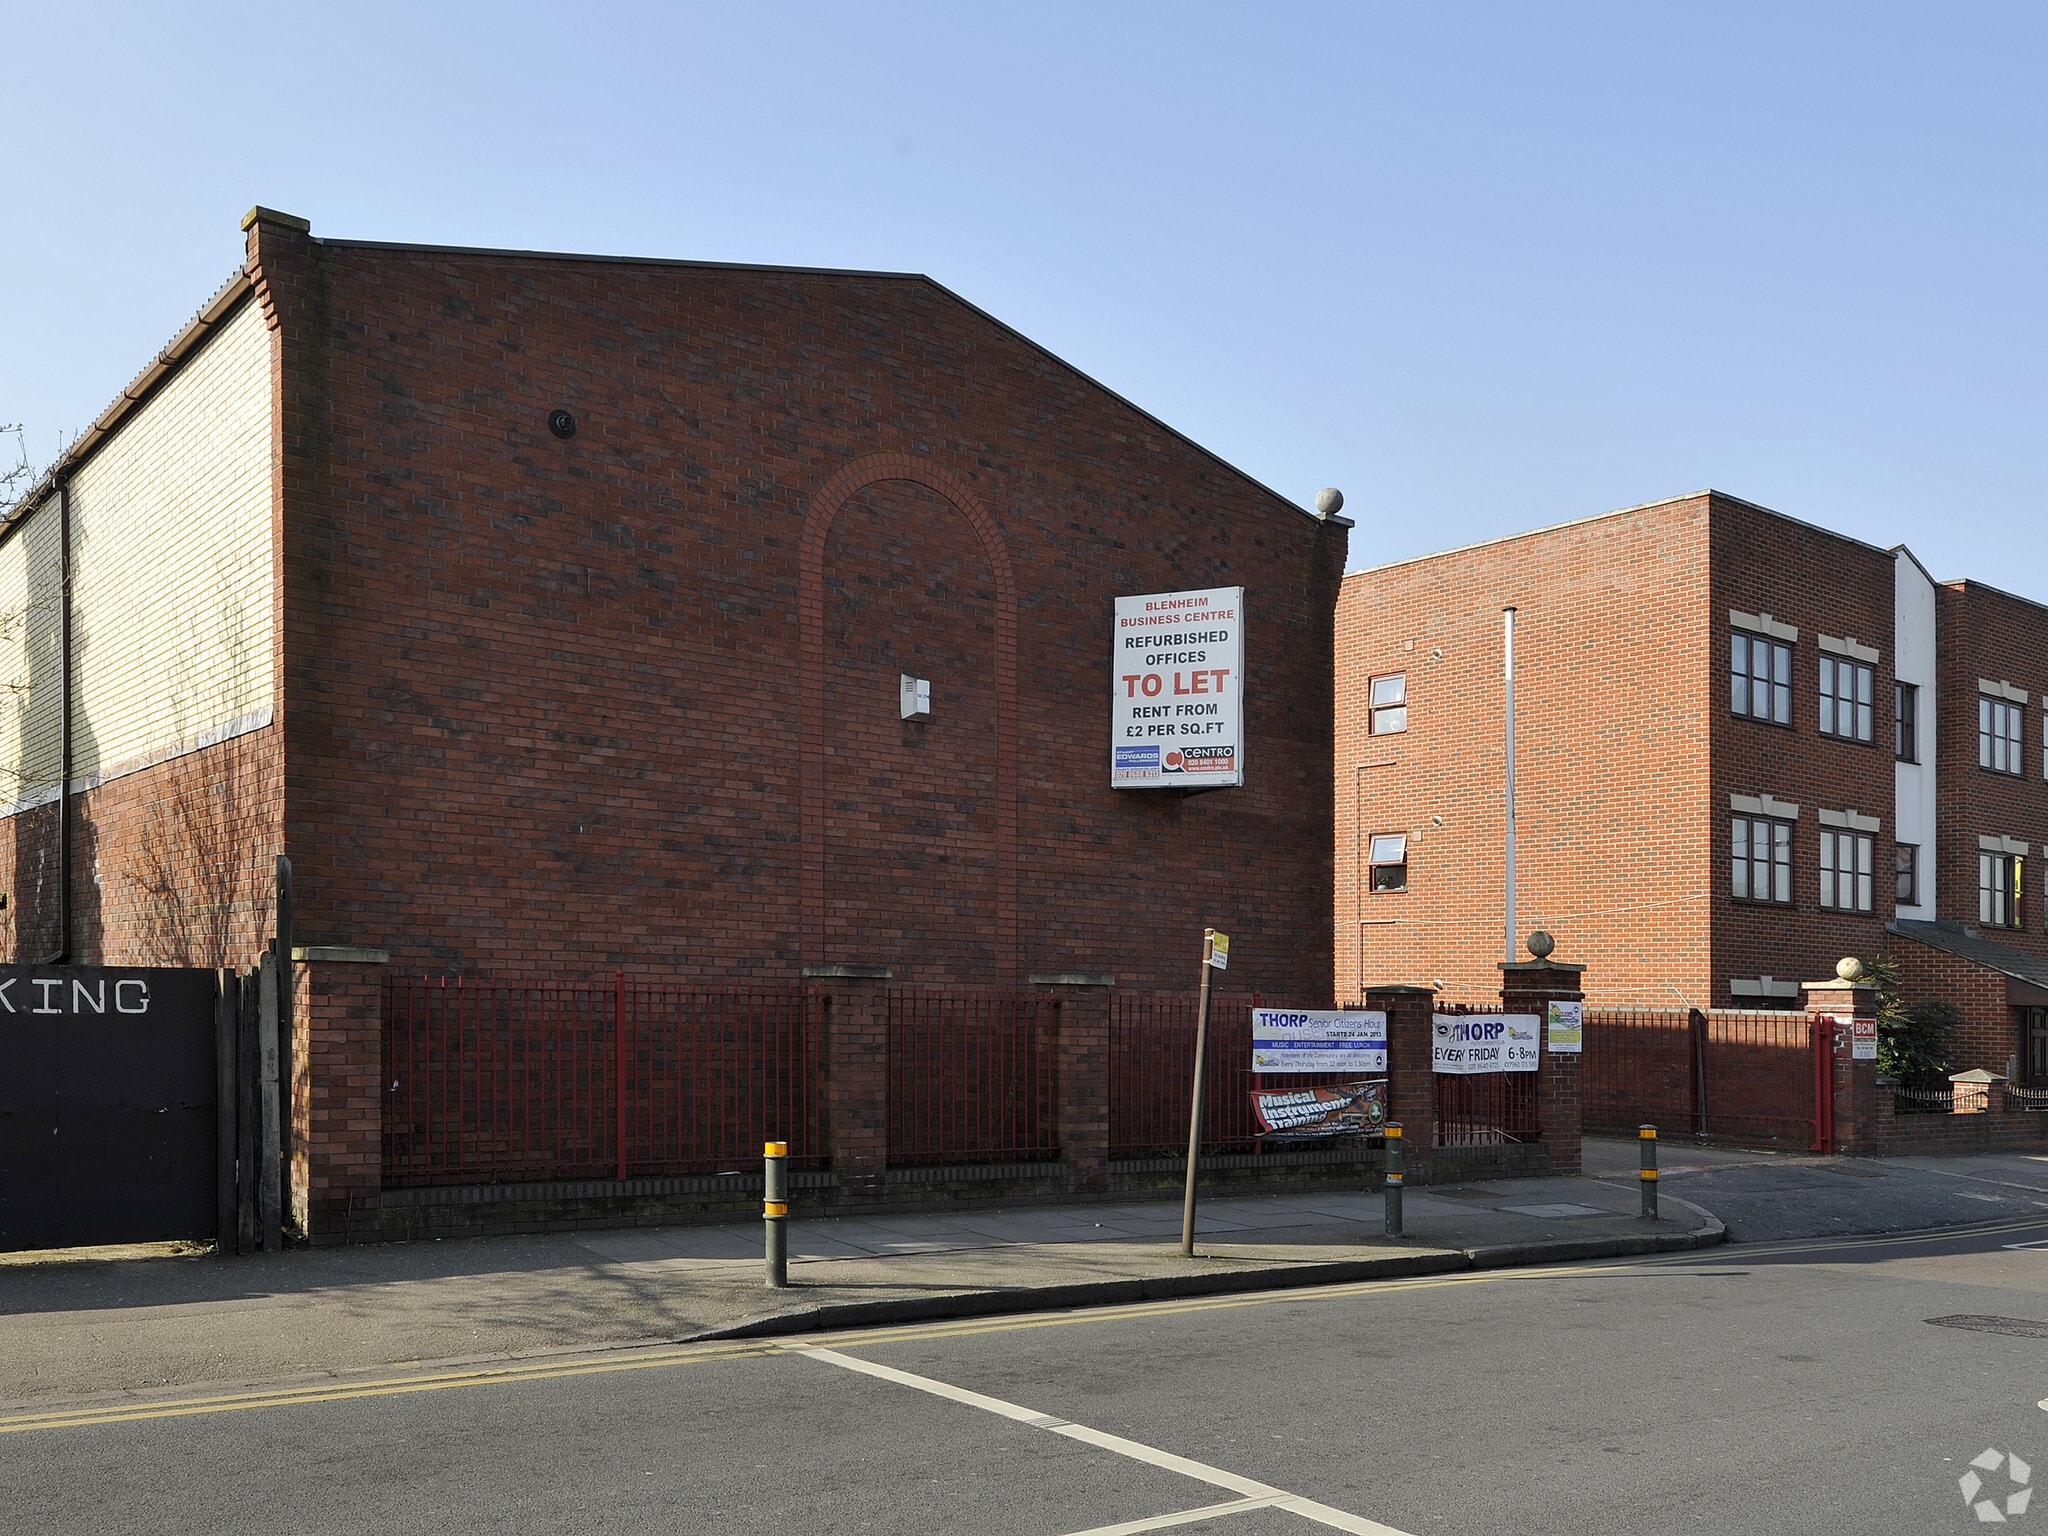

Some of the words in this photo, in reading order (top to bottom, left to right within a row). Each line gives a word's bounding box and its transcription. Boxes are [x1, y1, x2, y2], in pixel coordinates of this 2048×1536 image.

[1145, 597, 1208, 611] BLENHEIM
[1120, 613, 1180, 627] BUSINESS
[1184, 609, 1234, 622] CENTRE
[1125, 630, 1228, 648] REFURBISHED
[1146, 650, 1206, 666] OFFICES
[1122, 673, 1162, 697] TO
[1174, 669, 1230, 695] LET
[1132, 705, 1171, 718] RENT
[1176, 703, 1217, 716] FROM
[1126, 725, 1143, 737] £2
[1148, 723, 1175, 736] PER
[1180, 722, 1224, 735] SQ.FT
[1260, 1013, 1308, 1028] THORP
[1308, 1018, 1331, 1029] Senior
[1334, 1019, 1362, 1029] Citizens
[1364, 1019, 1381, 1029] Hour
[1855, 1022, 1874, 1035] BCM
[1454, 1022, 1505, 1042] THORP
[1434, 1047, 1465, 1062] EVERY
[1469, 1047, 1500, 1061] FRIDAY
[1258, 1090, 1317, 1108] Musical
[1261, 1097, 1352, 1120] Instruments
[1266, 1111, 1327, 1130] Training
